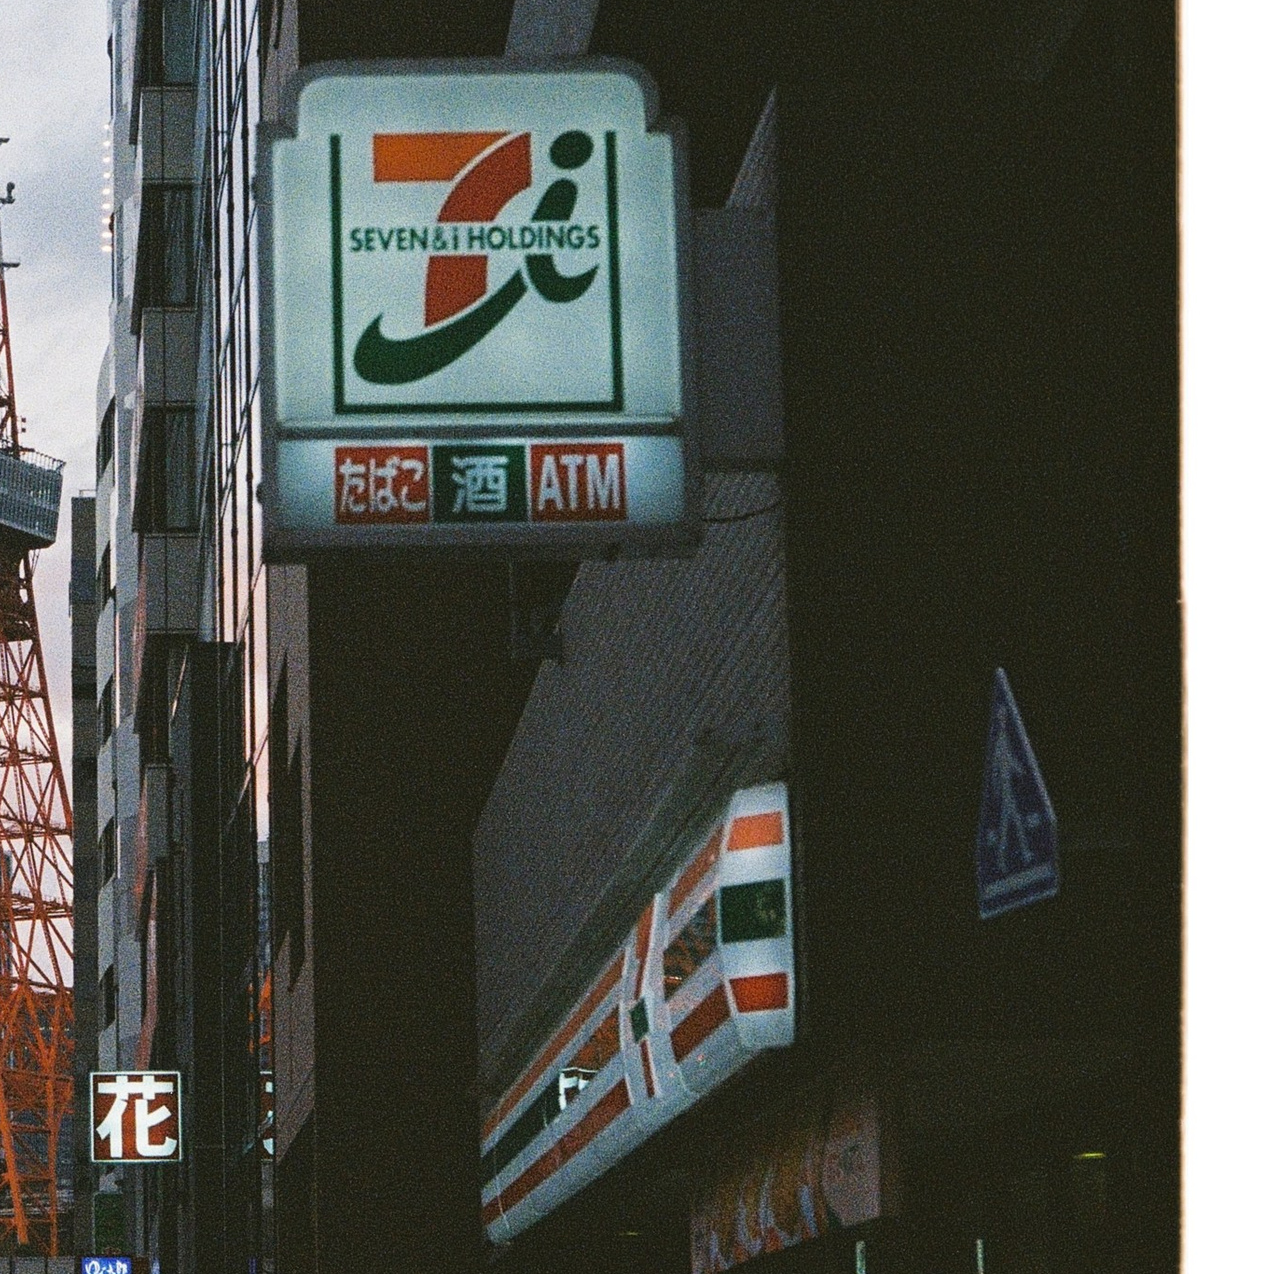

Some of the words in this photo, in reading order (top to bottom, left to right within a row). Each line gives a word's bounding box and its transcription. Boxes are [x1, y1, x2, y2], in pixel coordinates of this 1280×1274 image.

[468, 225, 601, 251] HOLDINGS
[338, 456, 426, 514] たばこ
[451, 454, 508, 512] 酒
[538, 452, 621, 512] ATM
[95, 1075, 178, 1158] 花
